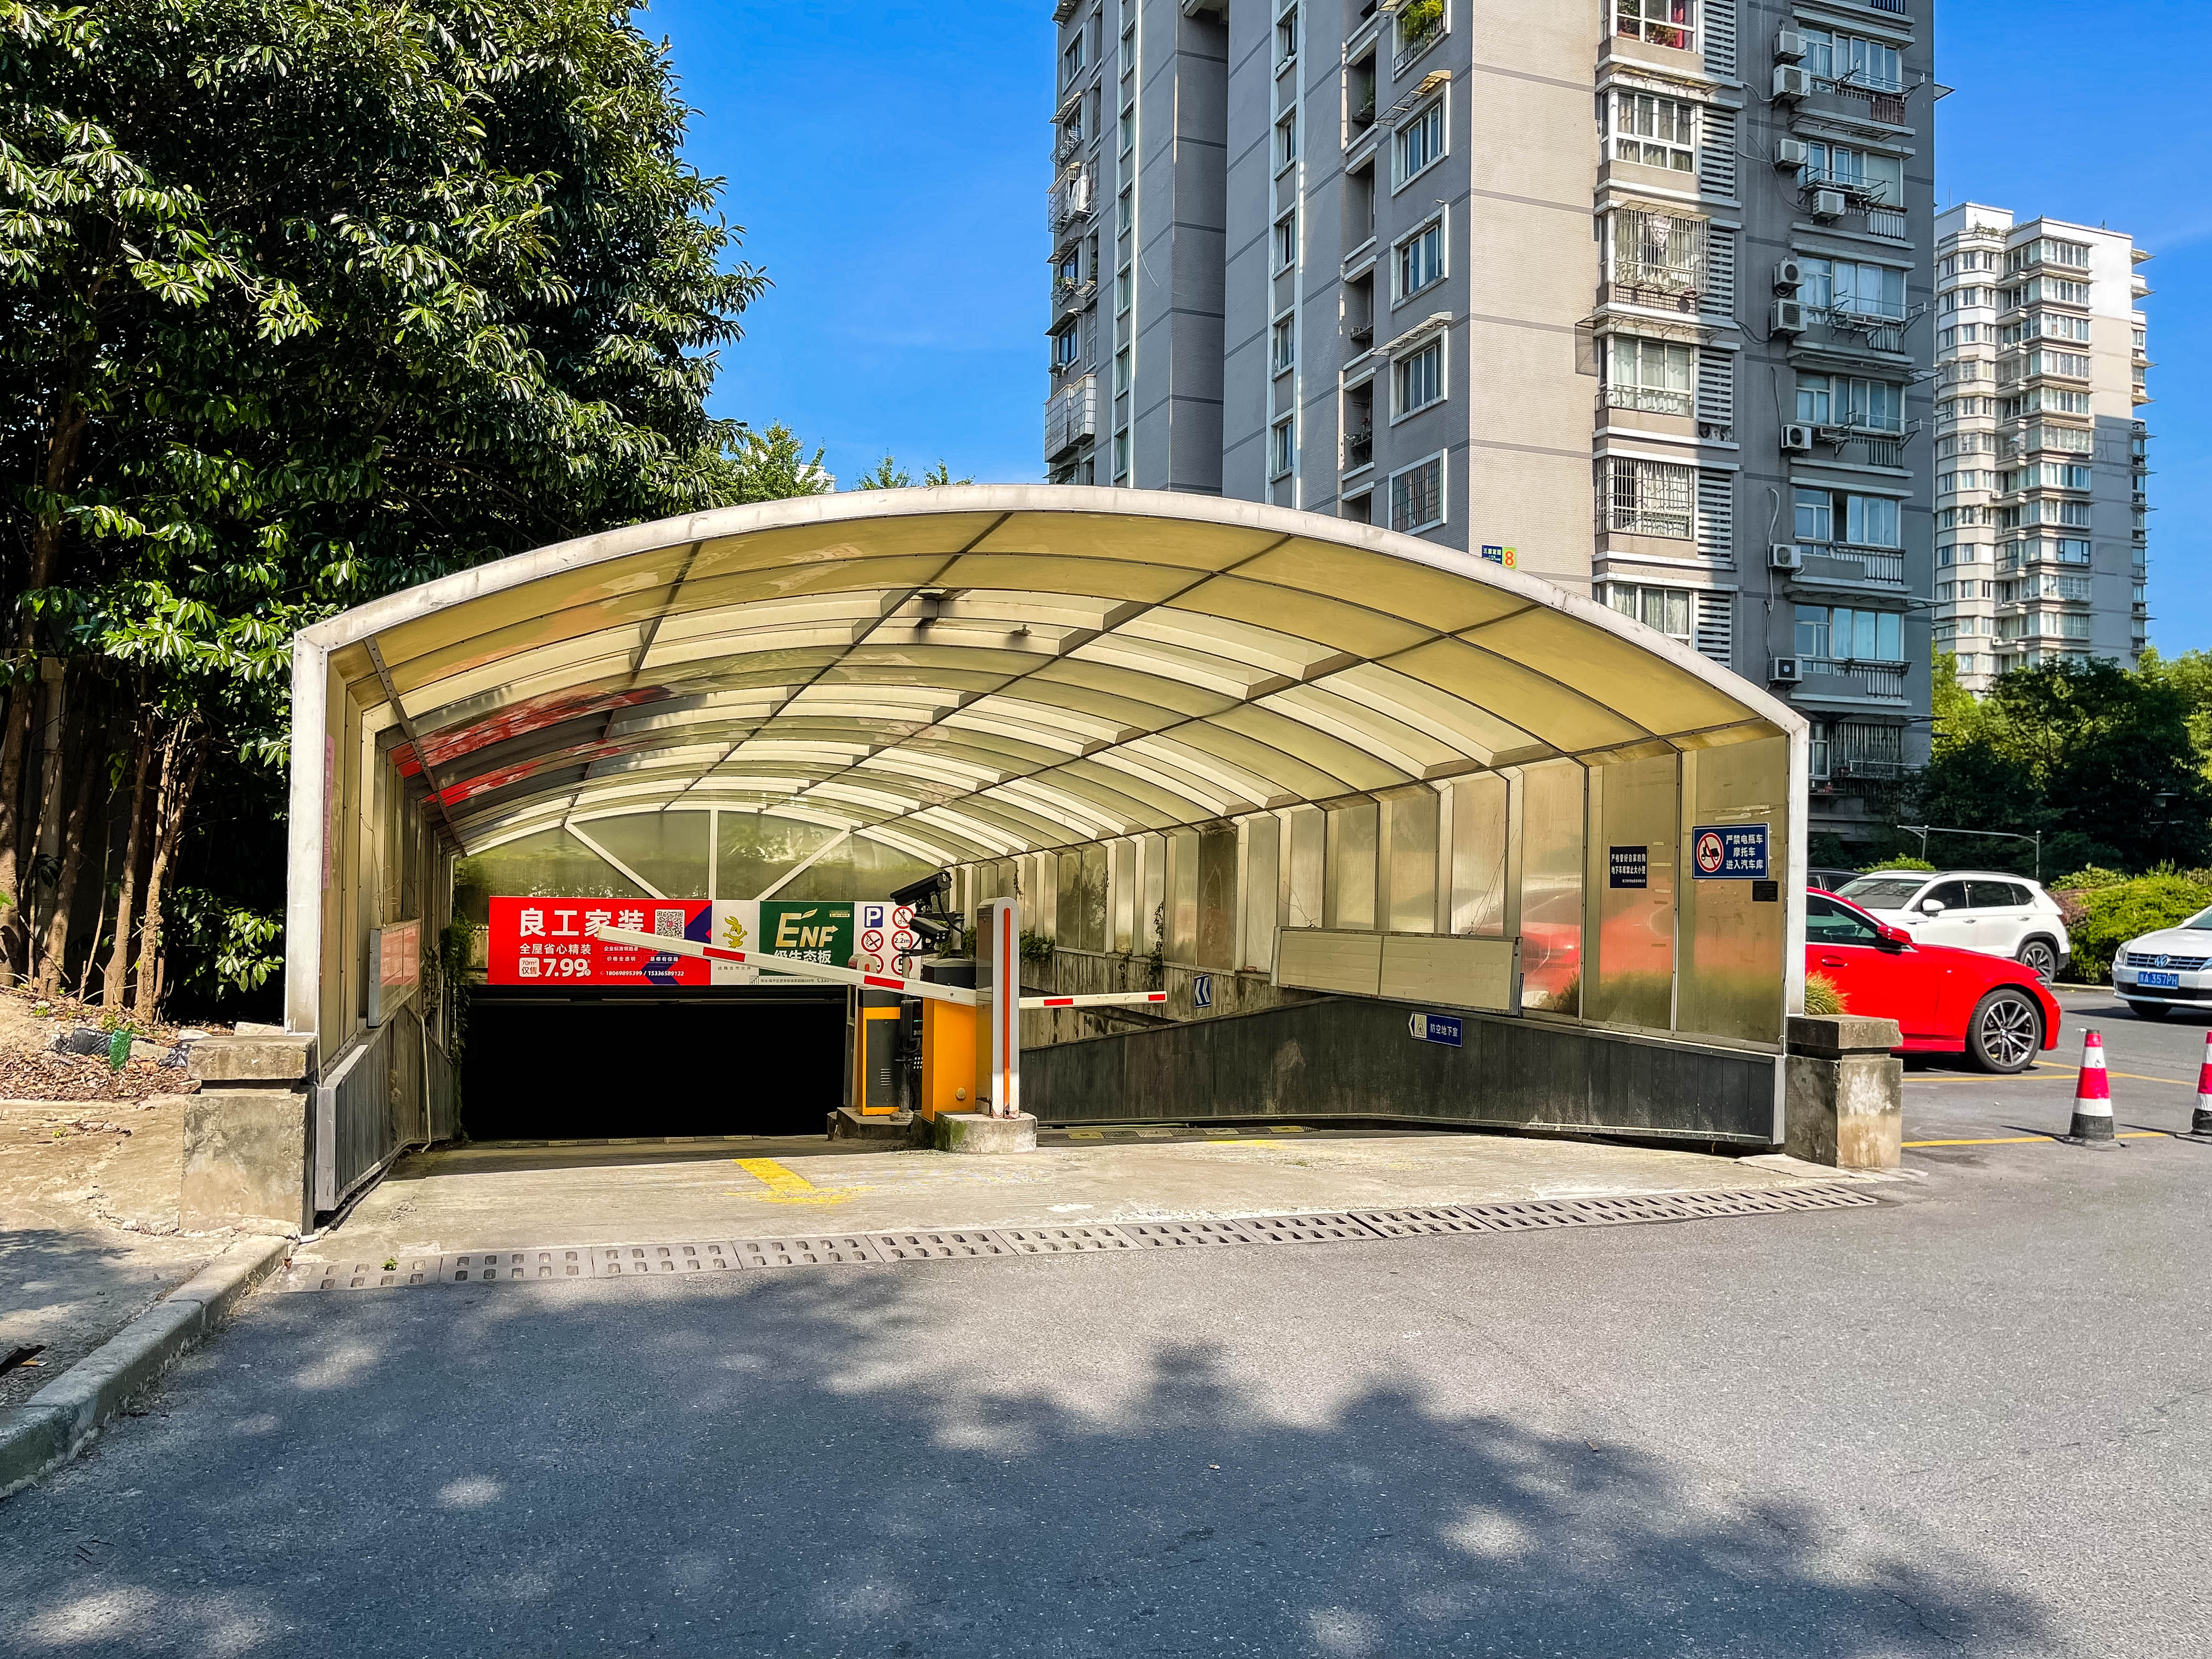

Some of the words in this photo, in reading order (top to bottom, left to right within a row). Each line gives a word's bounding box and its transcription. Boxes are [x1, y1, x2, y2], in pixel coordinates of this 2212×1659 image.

[1505, 551, 1514, 566] 8
[1725, 833, 1763, 845] 严禁电瓶车
[1733, 847, 1756, 857] 摩托车
[1611, 866, 1646, 874] 地下车库禁止大小便
[1726, 859, 1764, 870] 进入汽车库
[519, 907, 645, 938] 良工家装
[775, 912, 839, 948] ENF
[519, 943, 592, 955] 全屋省心精装
[522, 967, 538, 975] 仅售
[543, 958, 588, 977] 7.99
[1430, 1023, 1458, 1037] 防空地下室
